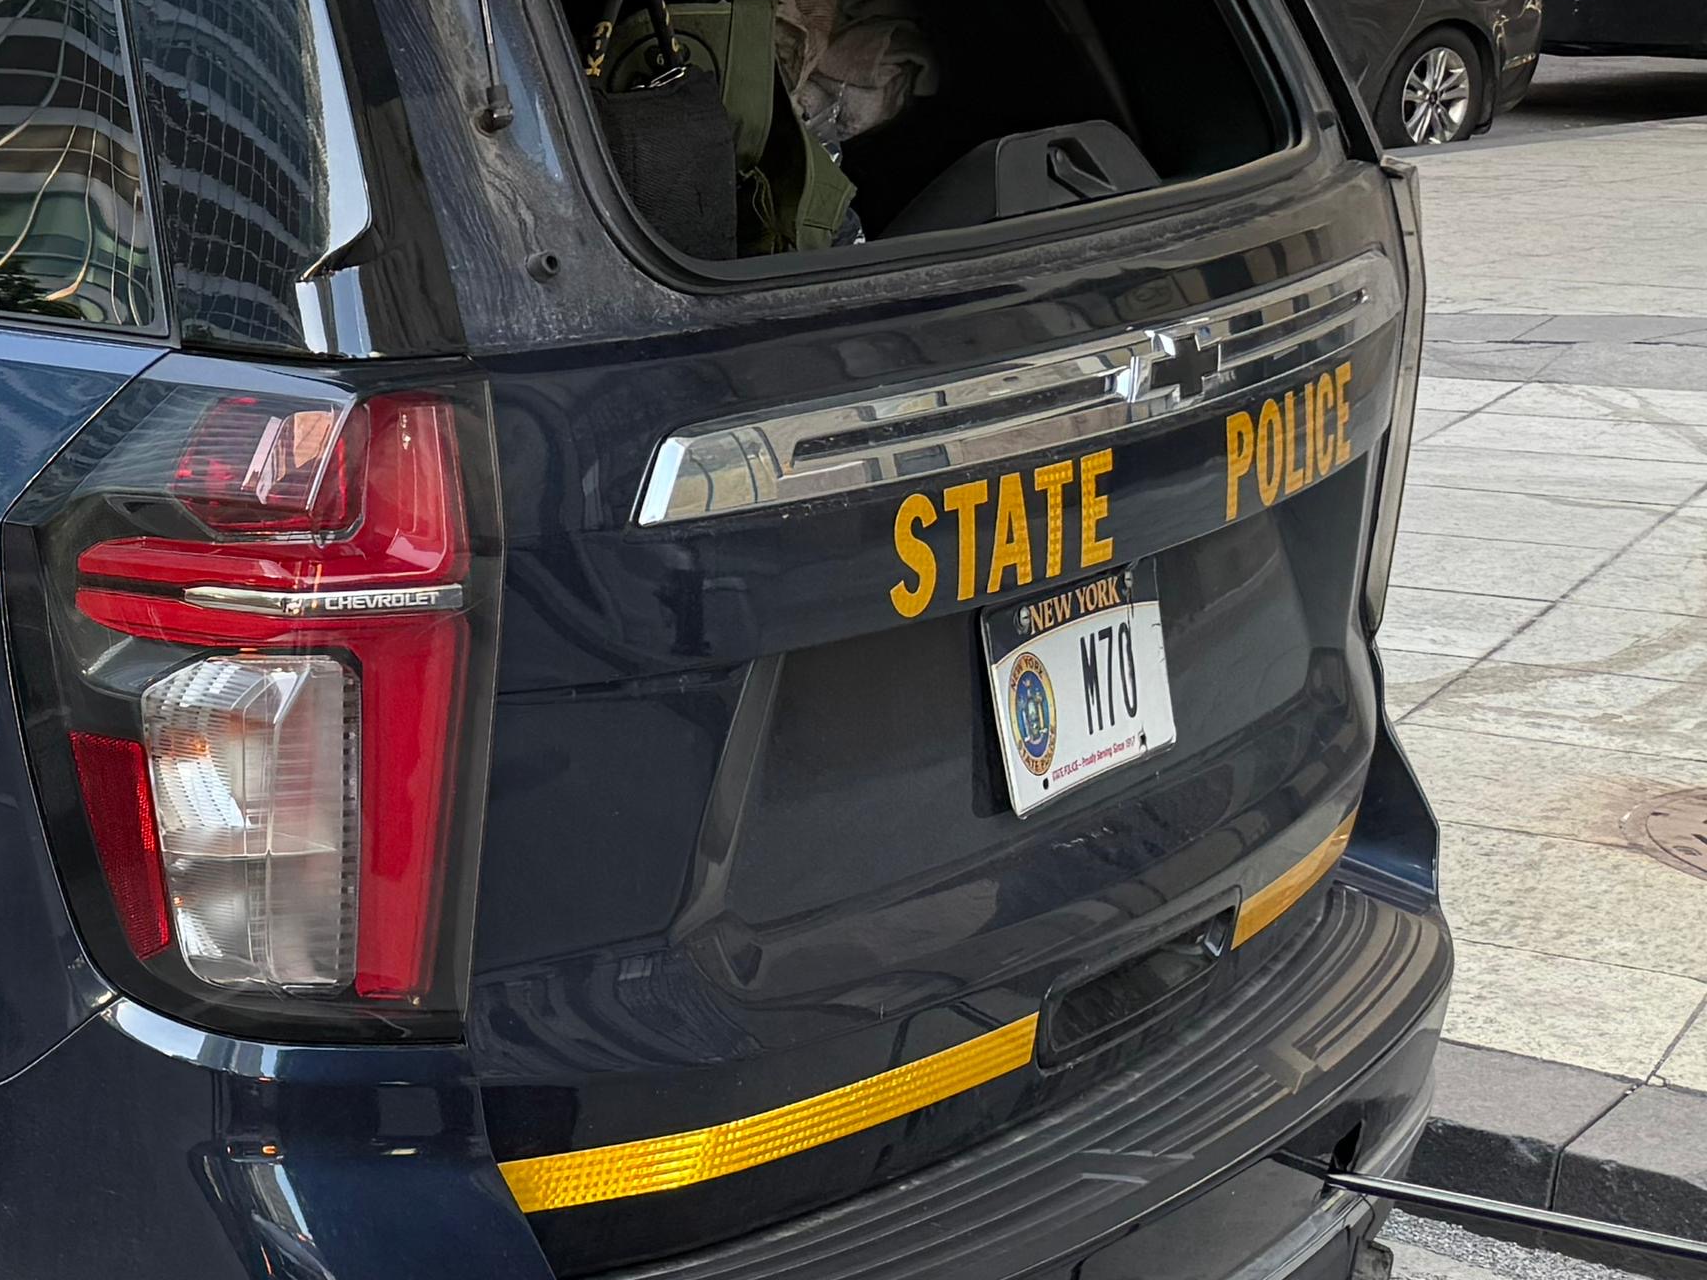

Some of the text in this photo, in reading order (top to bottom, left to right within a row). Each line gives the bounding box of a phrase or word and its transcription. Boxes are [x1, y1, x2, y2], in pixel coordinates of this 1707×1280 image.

[889, 361, 1353, 618] STATE POLICE
[324, 591, 440, 611] CHEVROLET
[1028, 575, 1121, 636] NEW YORK
[1079, 621, 1138, 736] M70
